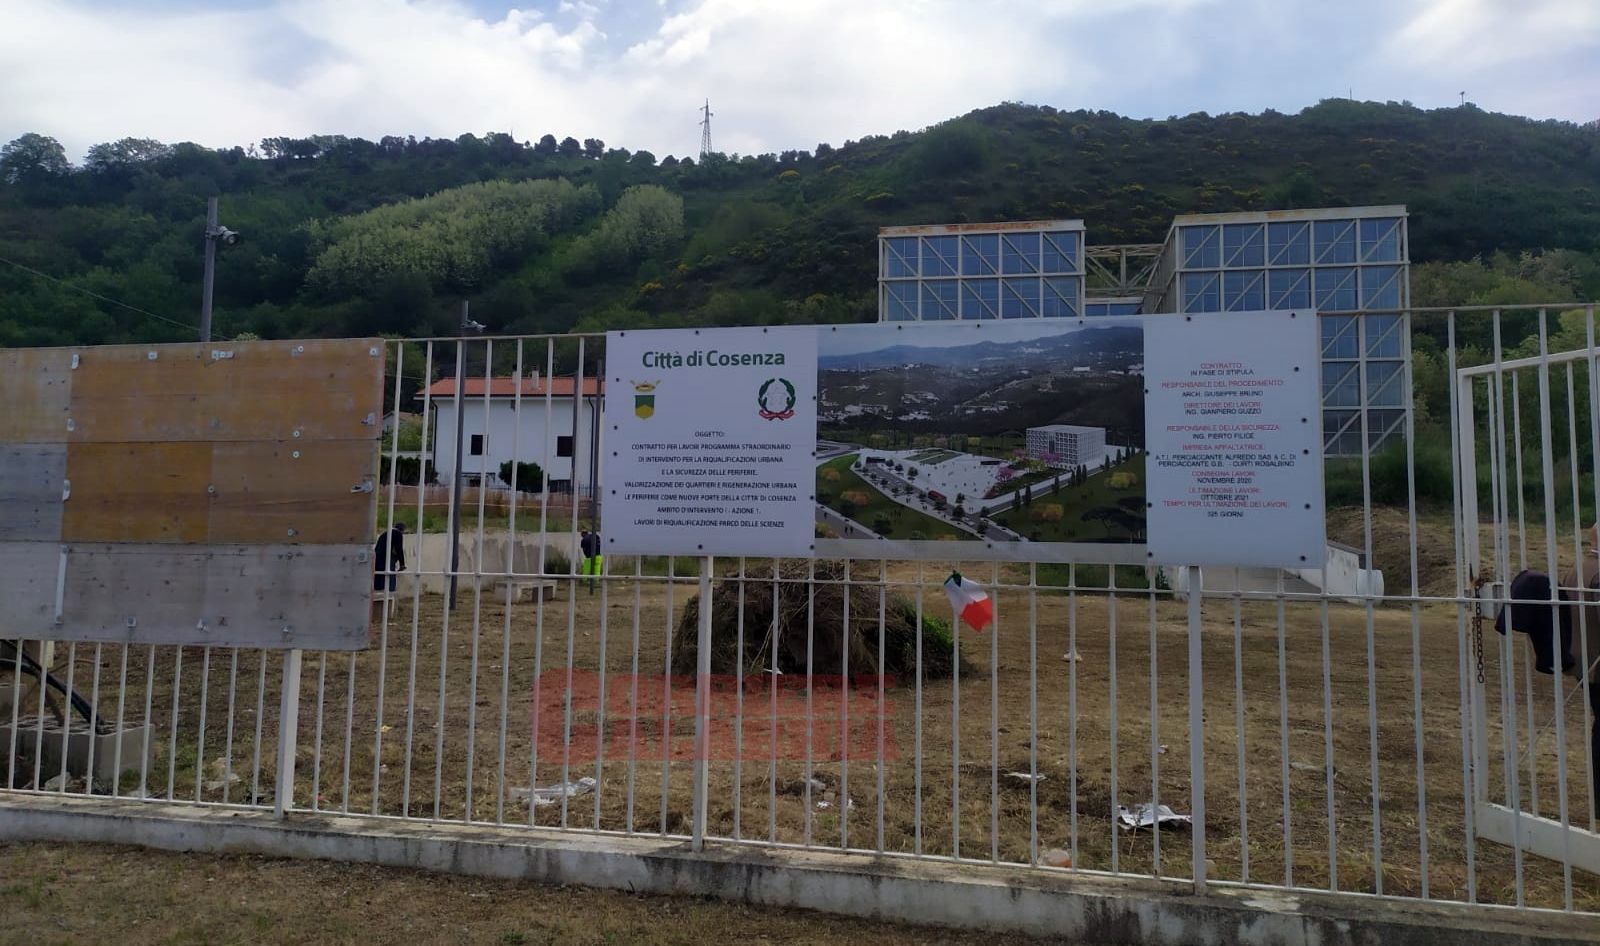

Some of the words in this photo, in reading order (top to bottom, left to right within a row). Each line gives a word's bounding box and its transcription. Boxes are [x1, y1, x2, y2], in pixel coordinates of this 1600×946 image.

[642, 351, 682, 369] Città
[687, 351, 702, 367] di
[707, 351, 785, 367] Cosenza
